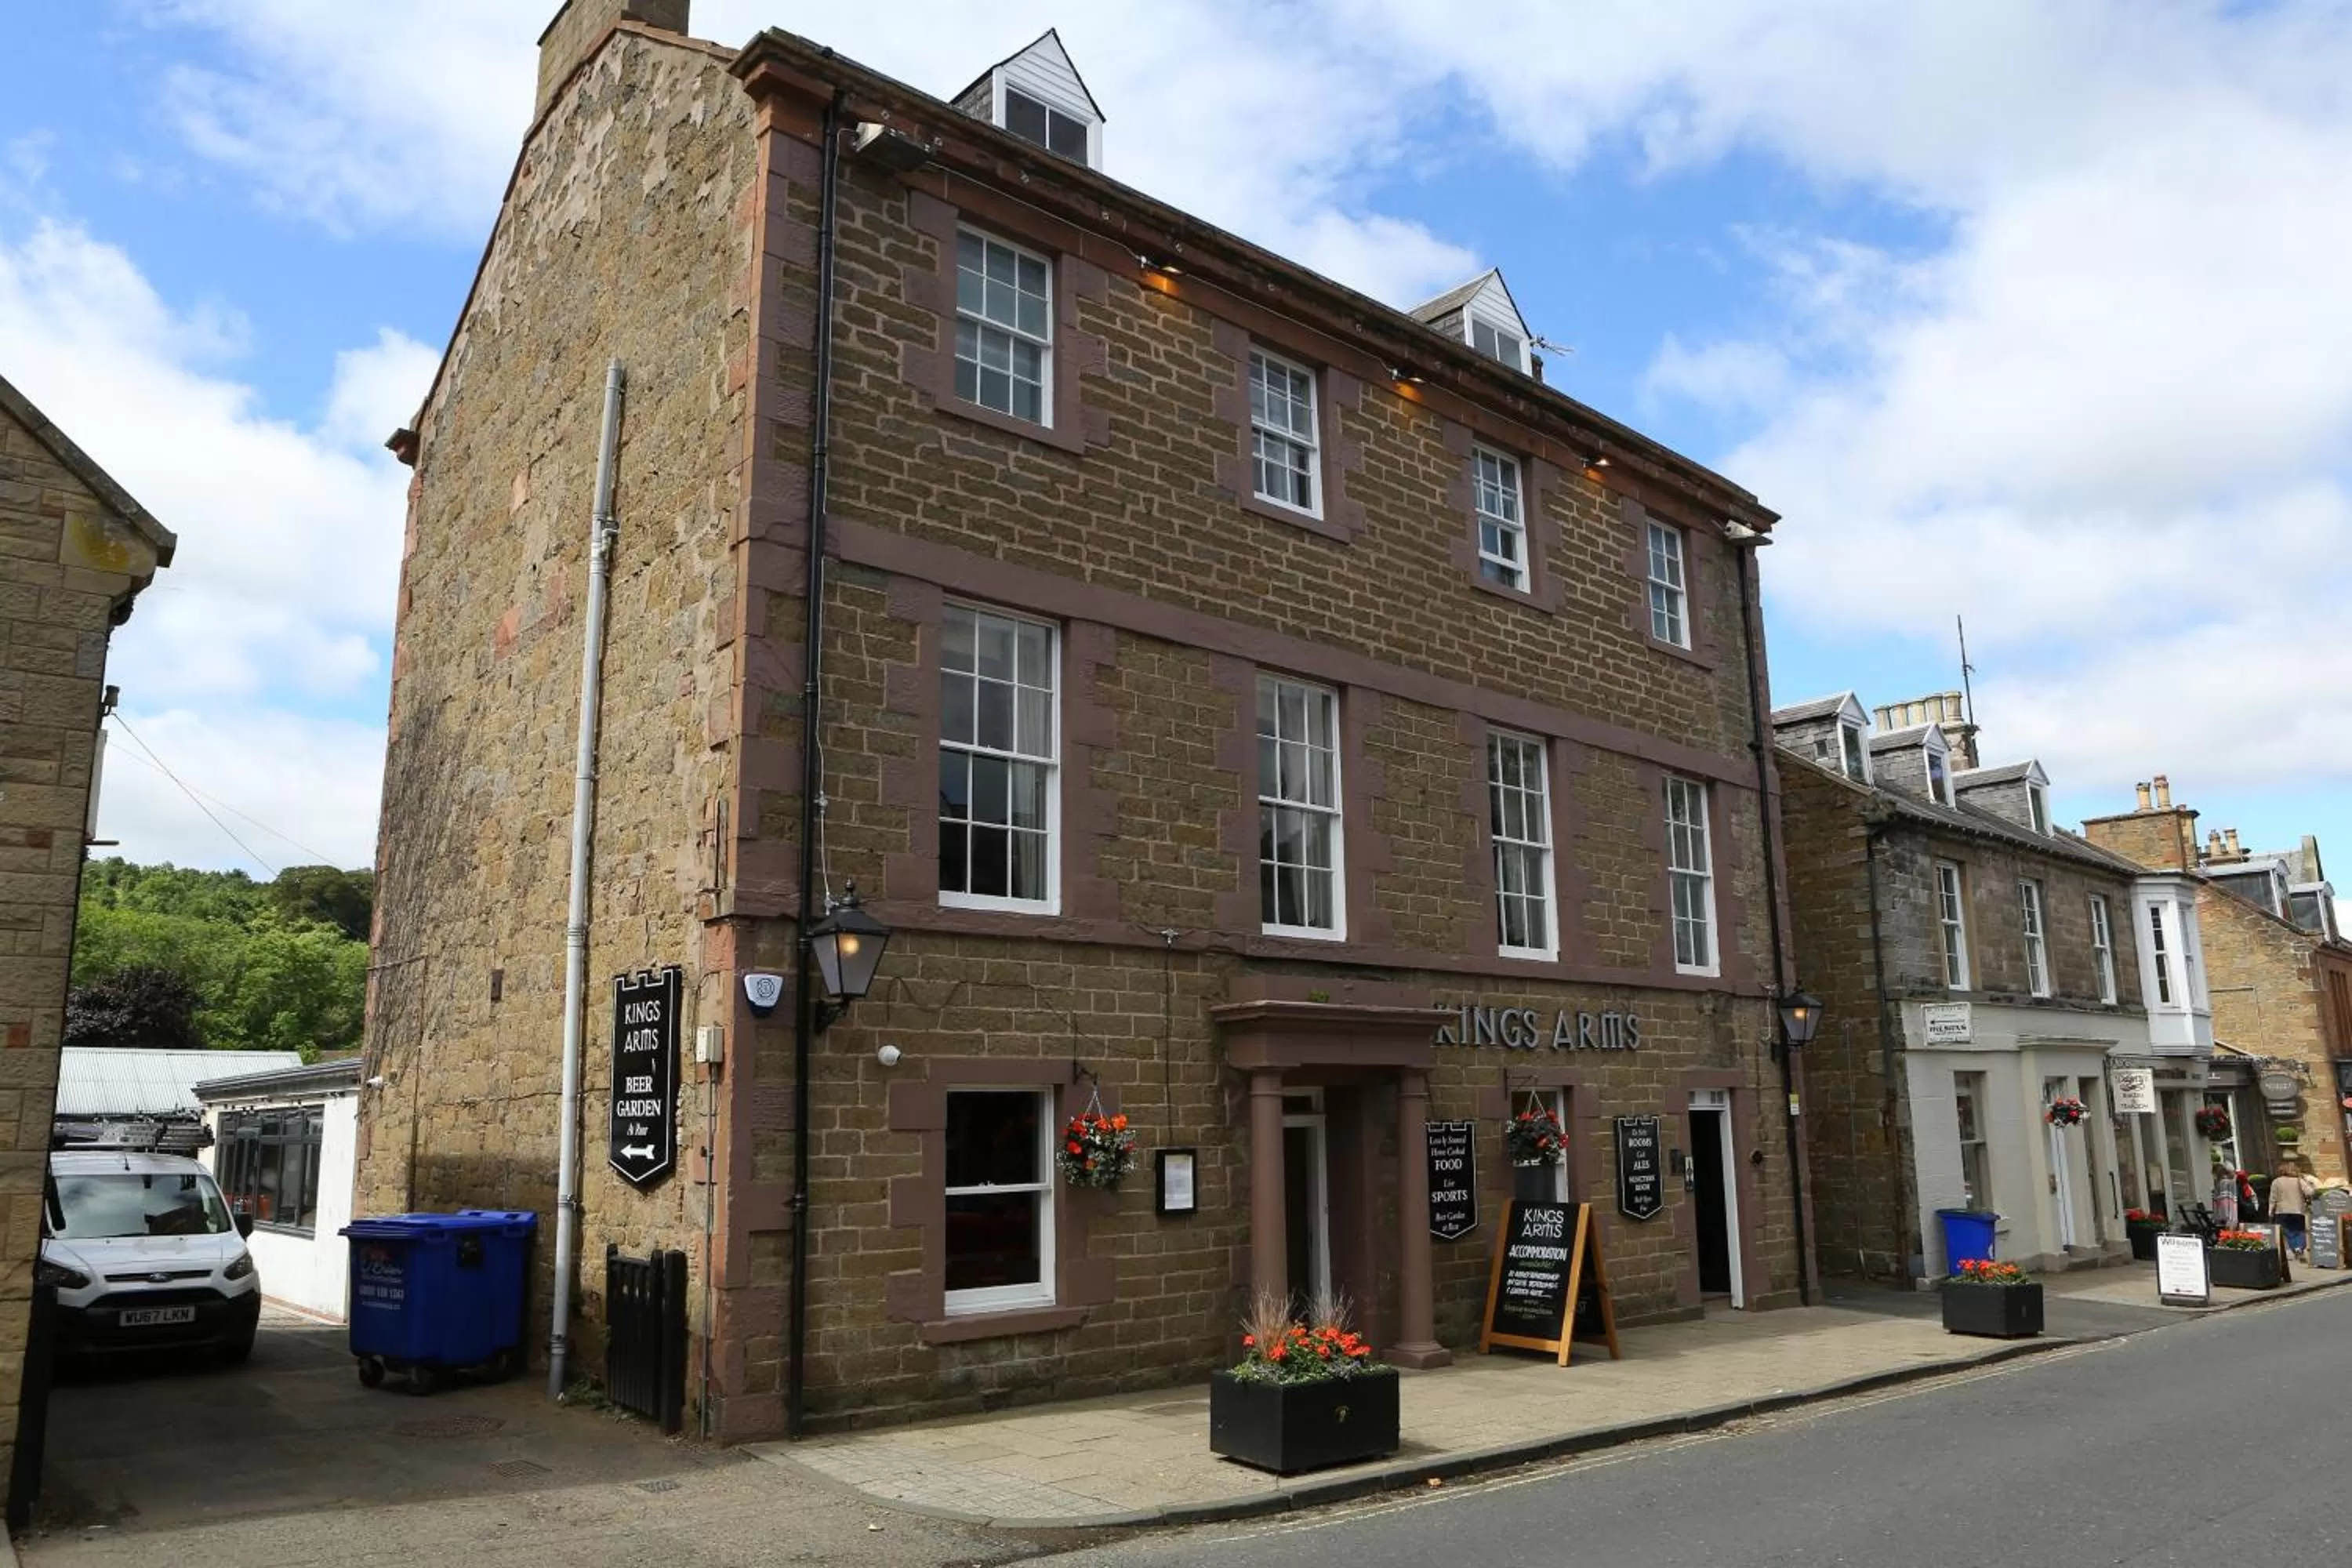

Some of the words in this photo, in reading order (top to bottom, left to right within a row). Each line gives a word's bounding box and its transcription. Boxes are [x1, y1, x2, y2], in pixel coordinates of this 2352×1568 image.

[625, 1000, 661, 1025] KINGS
[1552, 1009, 1640, 1051] ARMS
[623, 1028, 659, 1052] ARMS
[625, 1075, 653, 1093] BEER
[616, 1099, 661, 1117] GARDEN
[1435, 1158, 1462, 1171] FOOD
[1633, 1160, 1650, 1171] ALES
[1431, 1189, 1468, 1203] SPORTS
[1523, 1208, 1565, 1224] KINGS
[1521, 1223, 1563, 1239] ARMS
[1508, 1244, 1569, 1261] ACCOMMODATION
